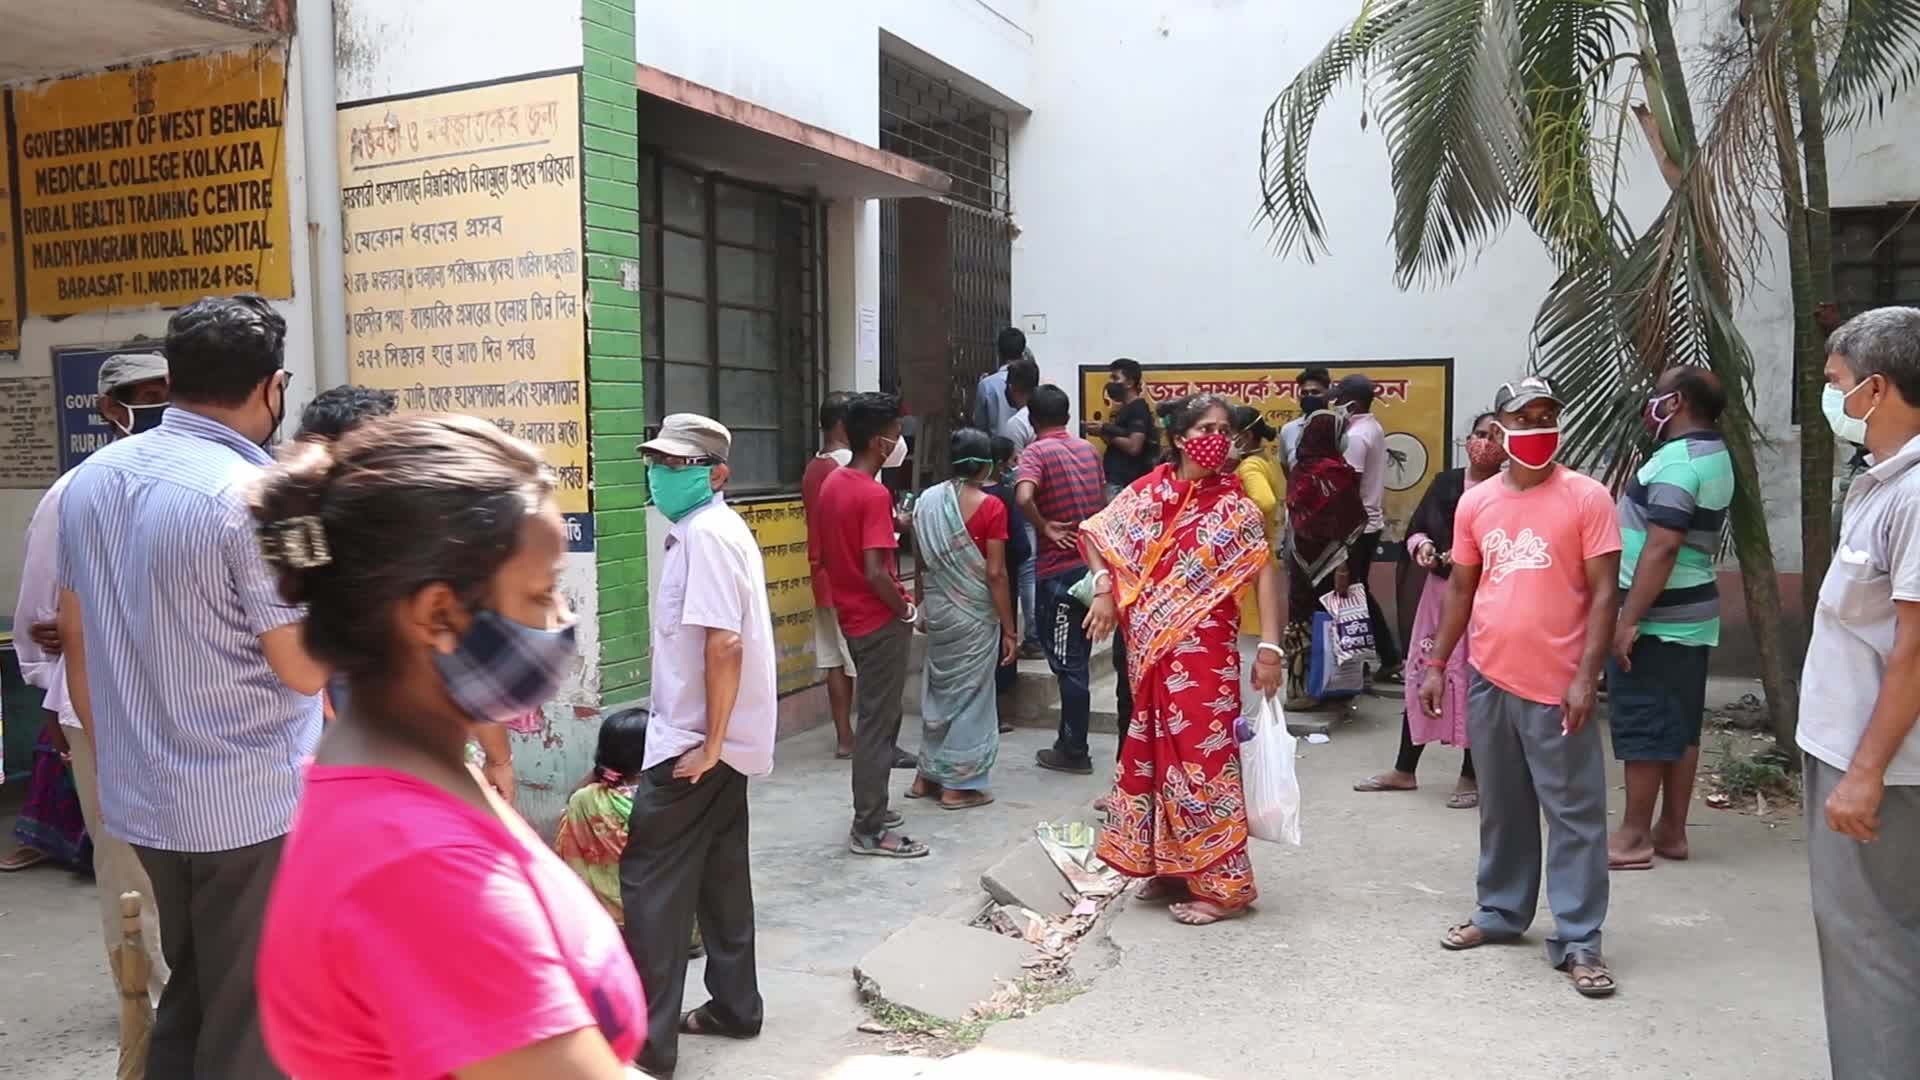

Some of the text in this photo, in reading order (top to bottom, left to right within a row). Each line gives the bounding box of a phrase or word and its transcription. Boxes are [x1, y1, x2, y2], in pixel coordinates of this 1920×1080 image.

[24, 97, 282, 159] GOVERNMENT OF WEST BENGAL
[35, 165, 109, 196] MEDICAL
[110, 151, 180, 185] COLLEGE
[183, 141, 264, 178] KOLKATA
[24, 179, 272, 235] RURAL HEALTH TRAINING CENTRE
[32, 220, 273, 270] MADHYANGRAM RURAL HOSPITAL
[201, 265, 222, 289] 24
